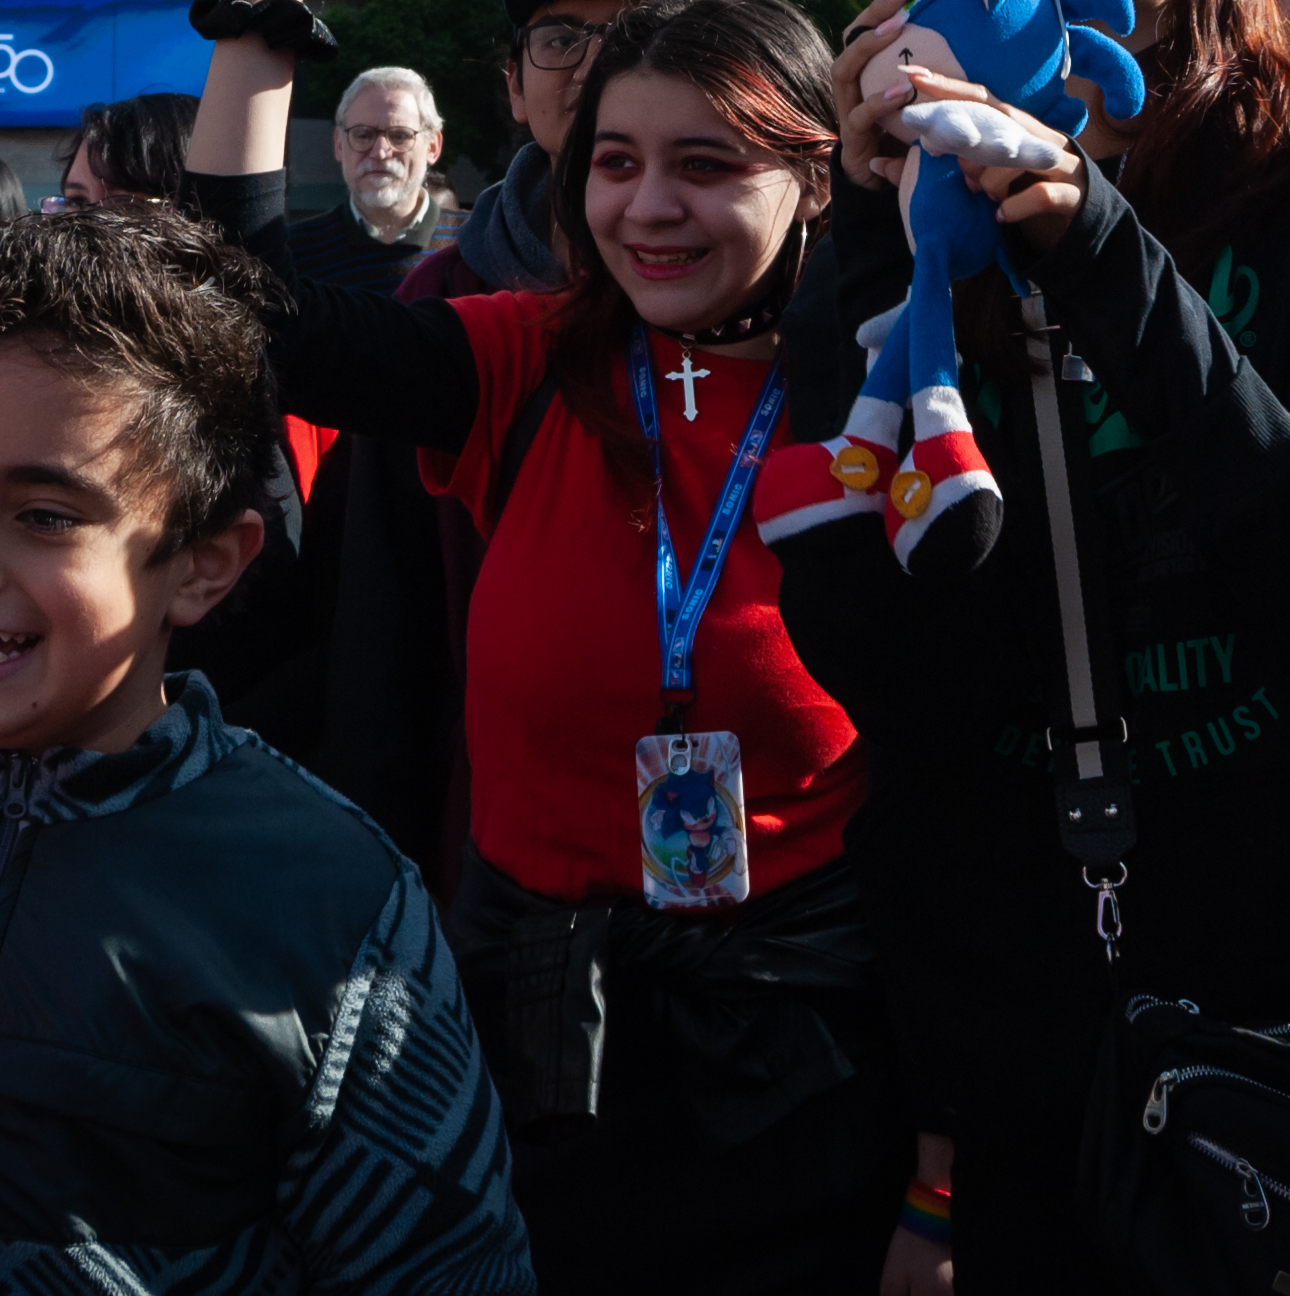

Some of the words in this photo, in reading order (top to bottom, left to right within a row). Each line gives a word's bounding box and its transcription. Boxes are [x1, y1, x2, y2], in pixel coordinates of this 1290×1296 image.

[638, 365, 648, 399] SONIC
[760, 386, 782, 417] SONIC
[722, 482, 744, 516] SONIC
[681, 587, 705, 621] SONIC
[1154, 686, 1280, 778] TRUST
